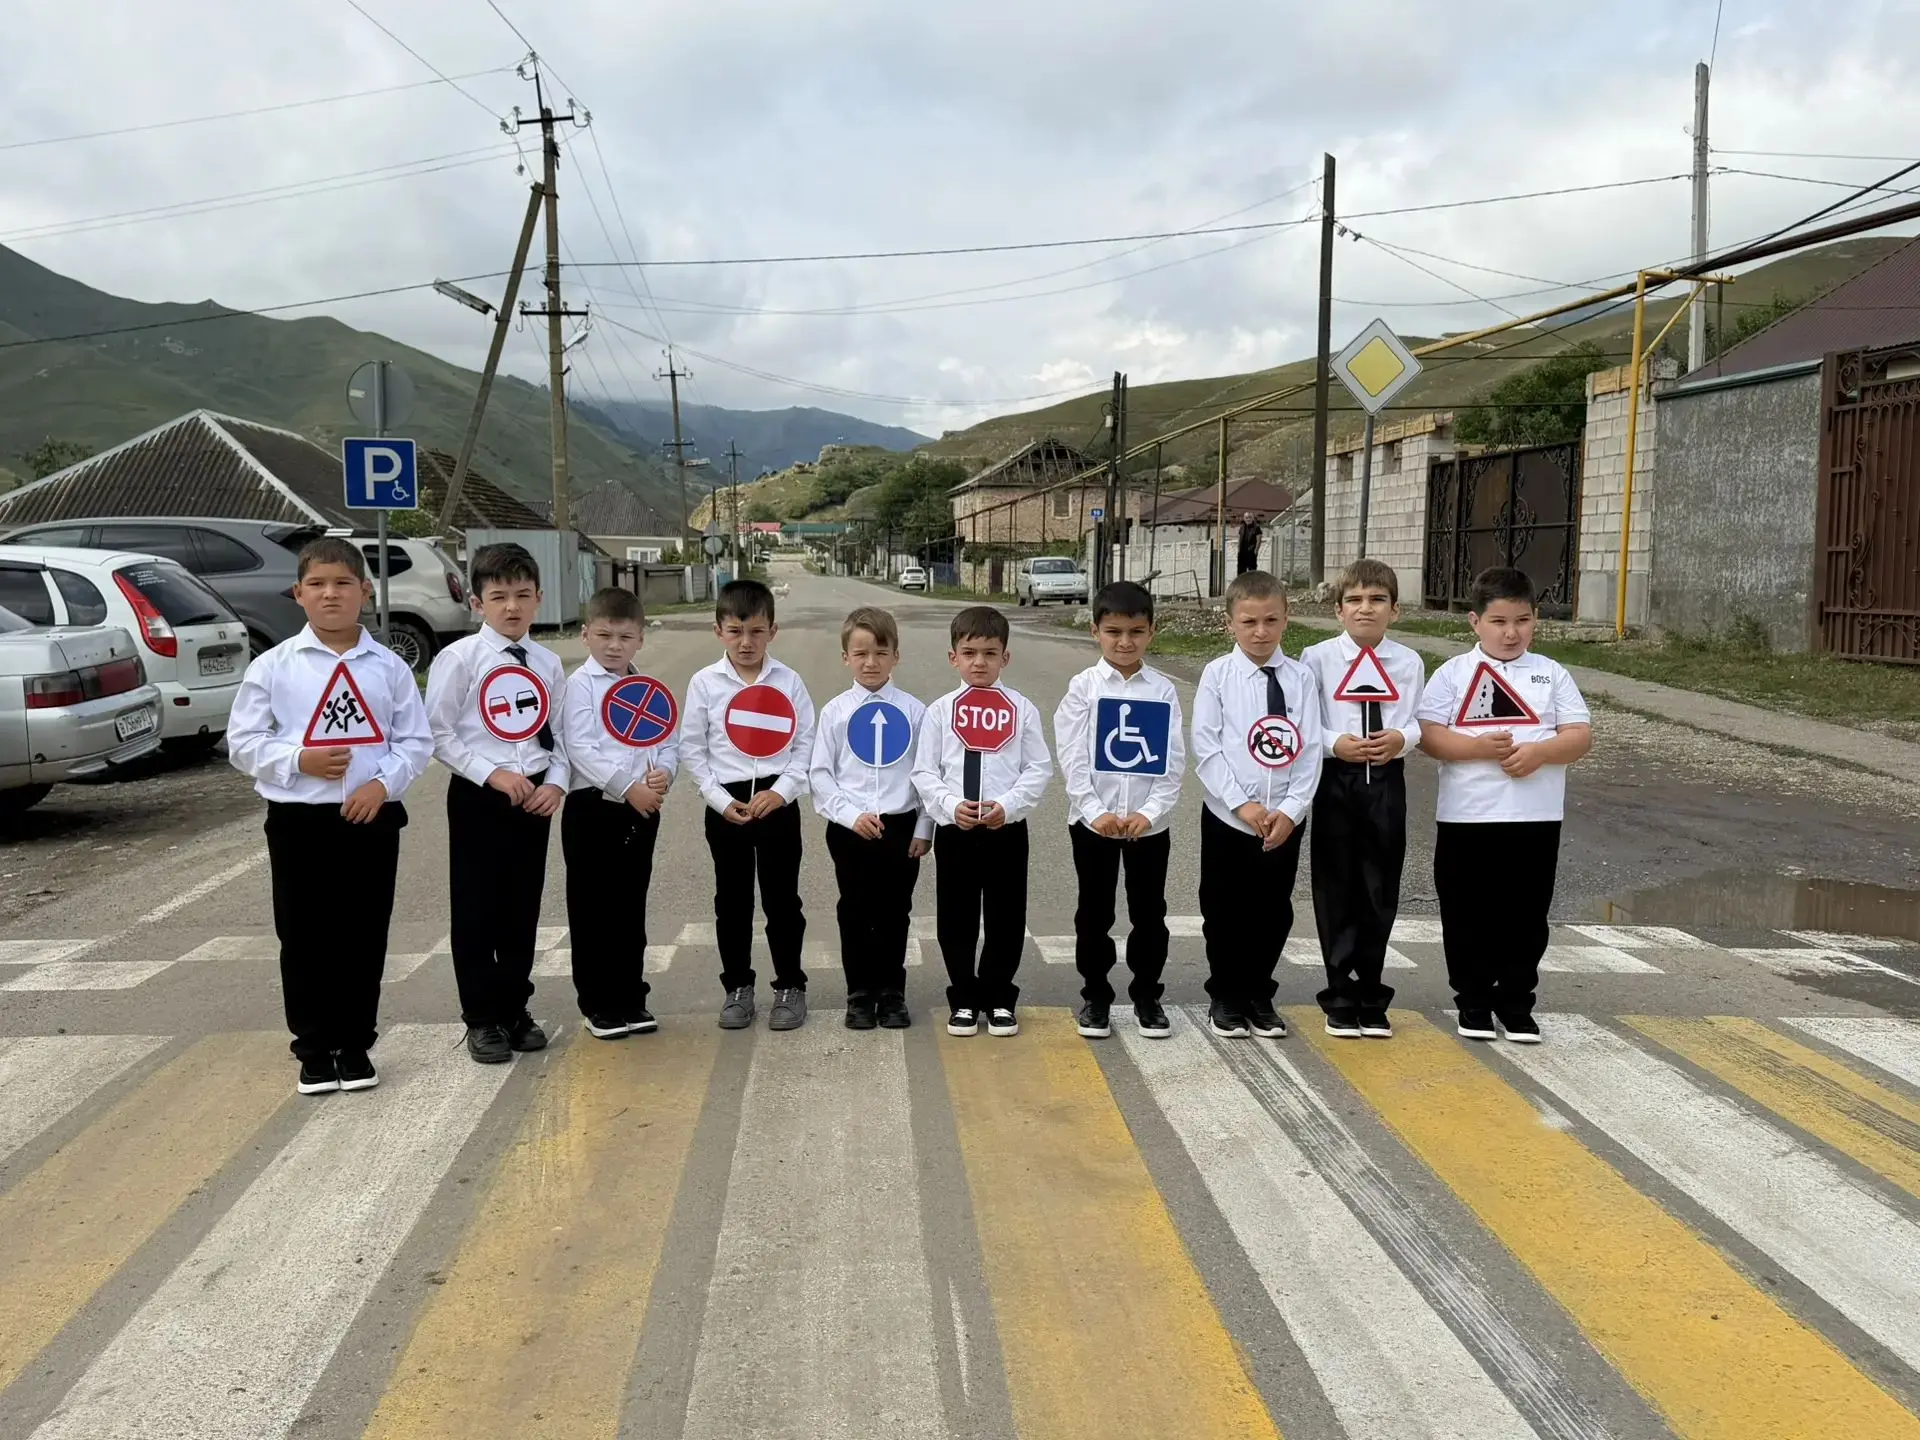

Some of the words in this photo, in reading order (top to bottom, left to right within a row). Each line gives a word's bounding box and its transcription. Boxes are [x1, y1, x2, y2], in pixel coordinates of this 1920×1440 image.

[364, 447, 402, 500] P
[1531, 674, 1551, 684] BOSS
[957, 704, 1011, 731] STOP
